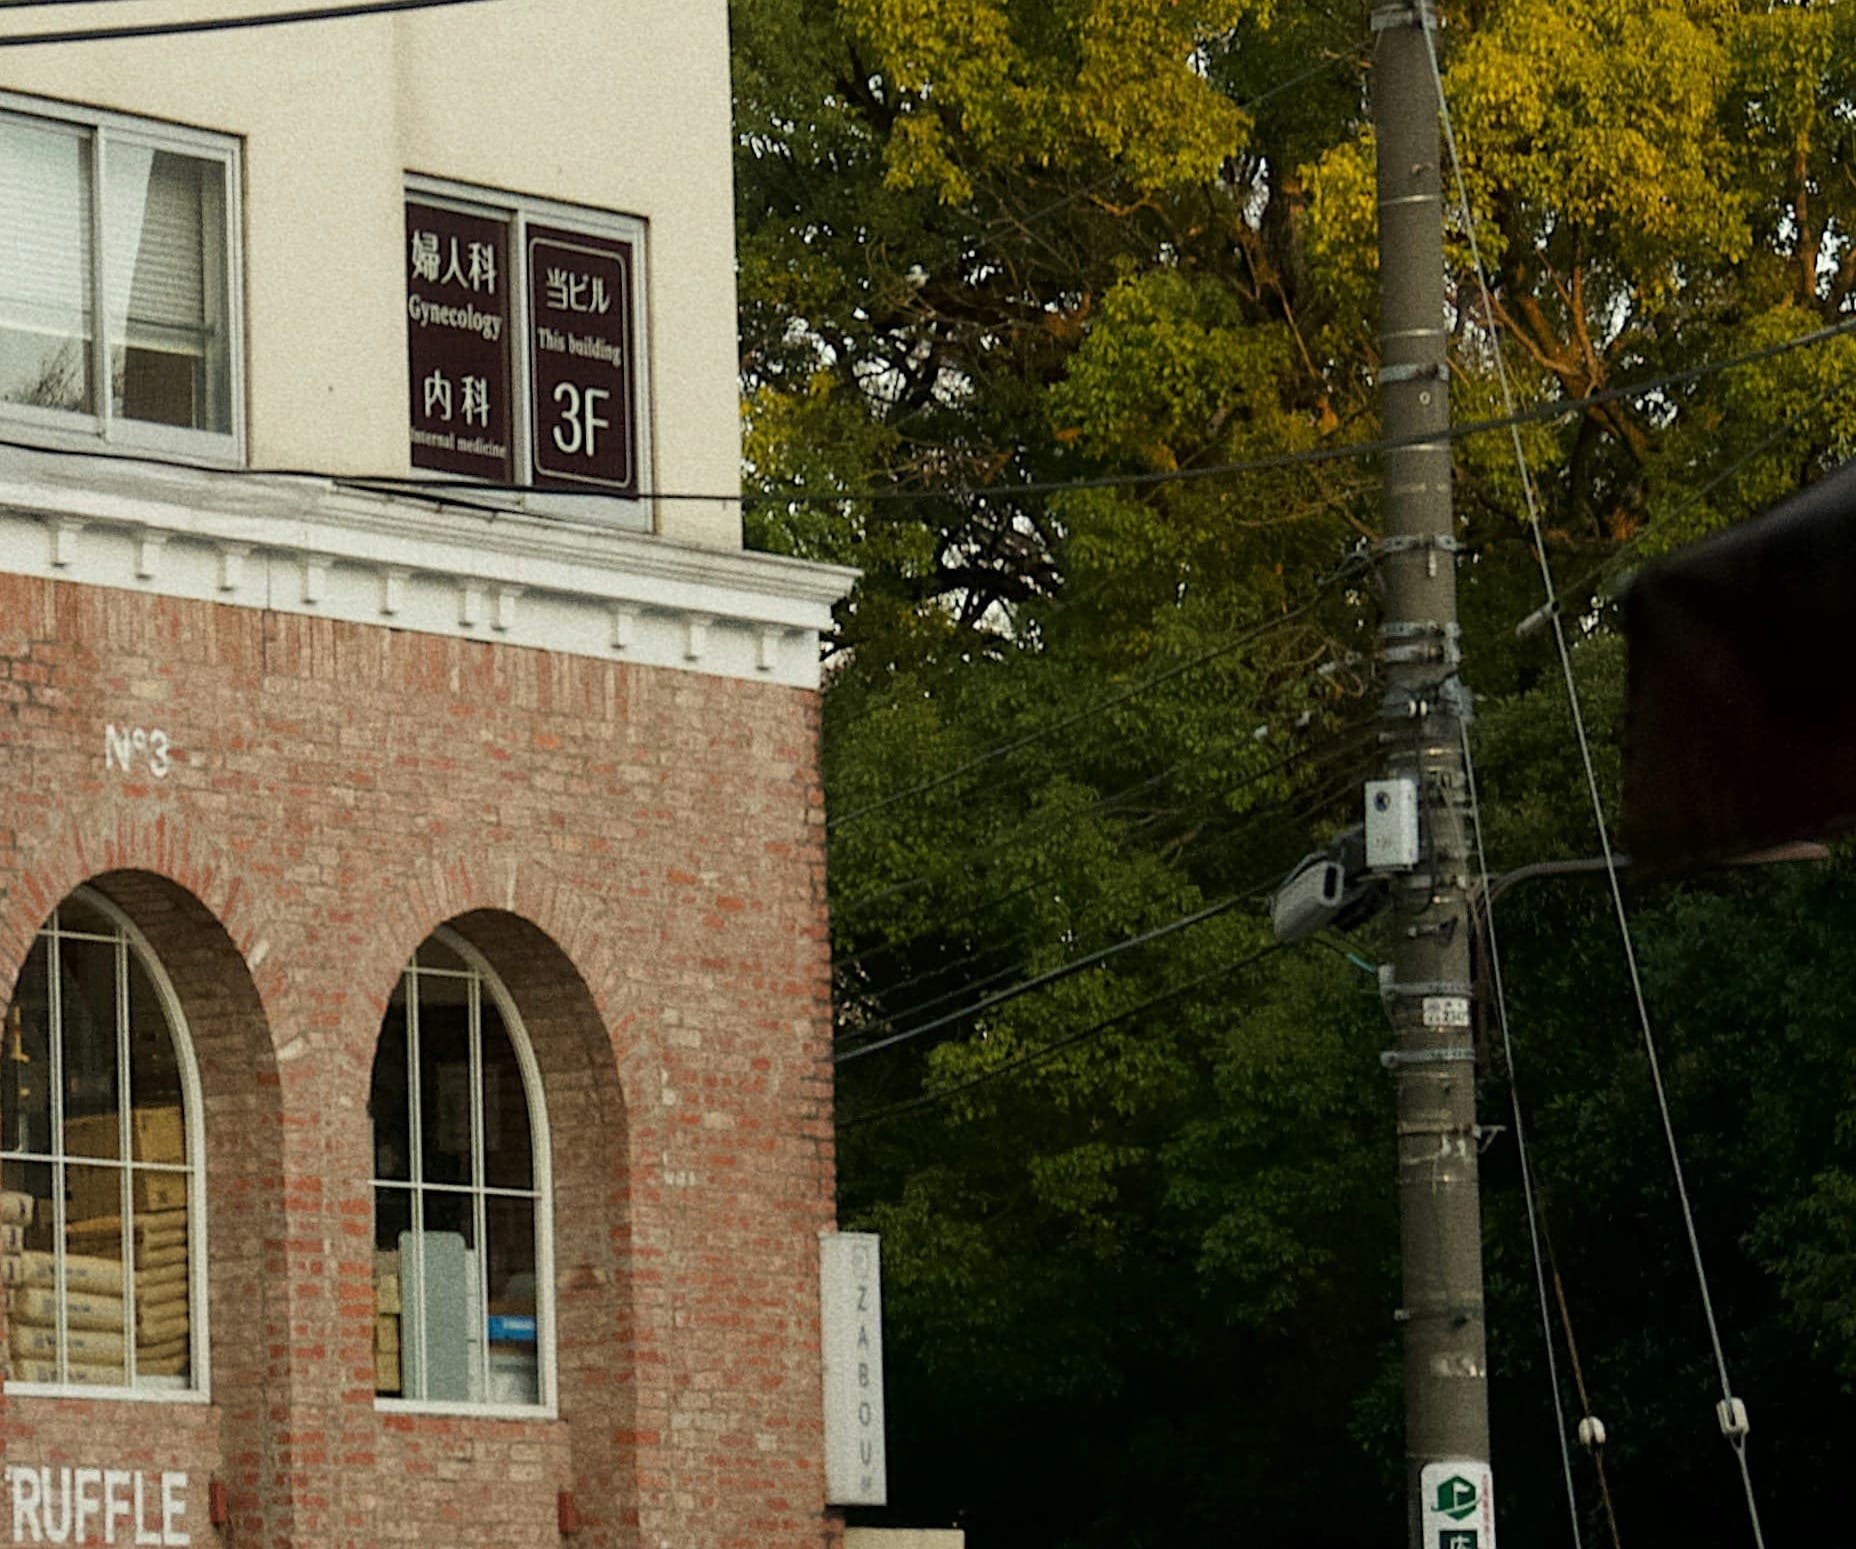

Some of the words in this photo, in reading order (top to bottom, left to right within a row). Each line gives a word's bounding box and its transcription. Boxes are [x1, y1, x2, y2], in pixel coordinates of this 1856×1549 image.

[411, 229, 497, 295] 婦人科
[408, 294, 503, 341] Gynecology
[546, 267, 611, 315] 当ビル
[538, 327, 565, 354] This
[568, 332, 623, 368] building
[424, 369, 491, 429] 内科
[553, 381, 611, 458] 3F
[410, 426, 456, 452] Internal
[457, 432, 507, 460] medicine
[5, 1465, 191, 1547] RUFFLE
